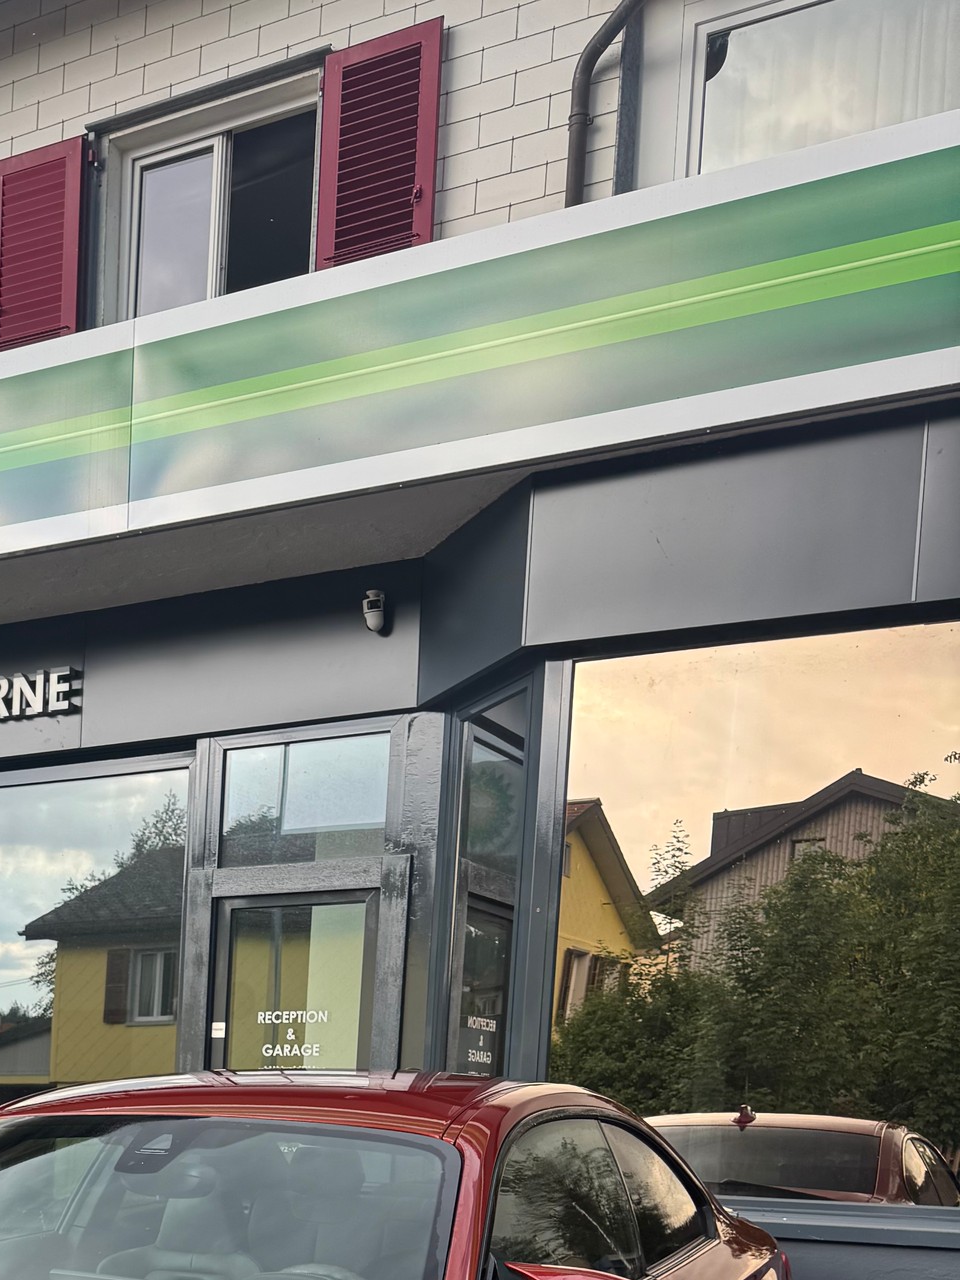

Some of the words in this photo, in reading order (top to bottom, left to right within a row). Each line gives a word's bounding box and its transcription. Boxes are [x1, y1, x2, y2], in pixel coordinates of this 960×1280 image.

[257, 1010, 328, 1024] RECEPTION
[286, 1028, 296, 1040] &
[261, 1043, 320, 1057] GARAGE
